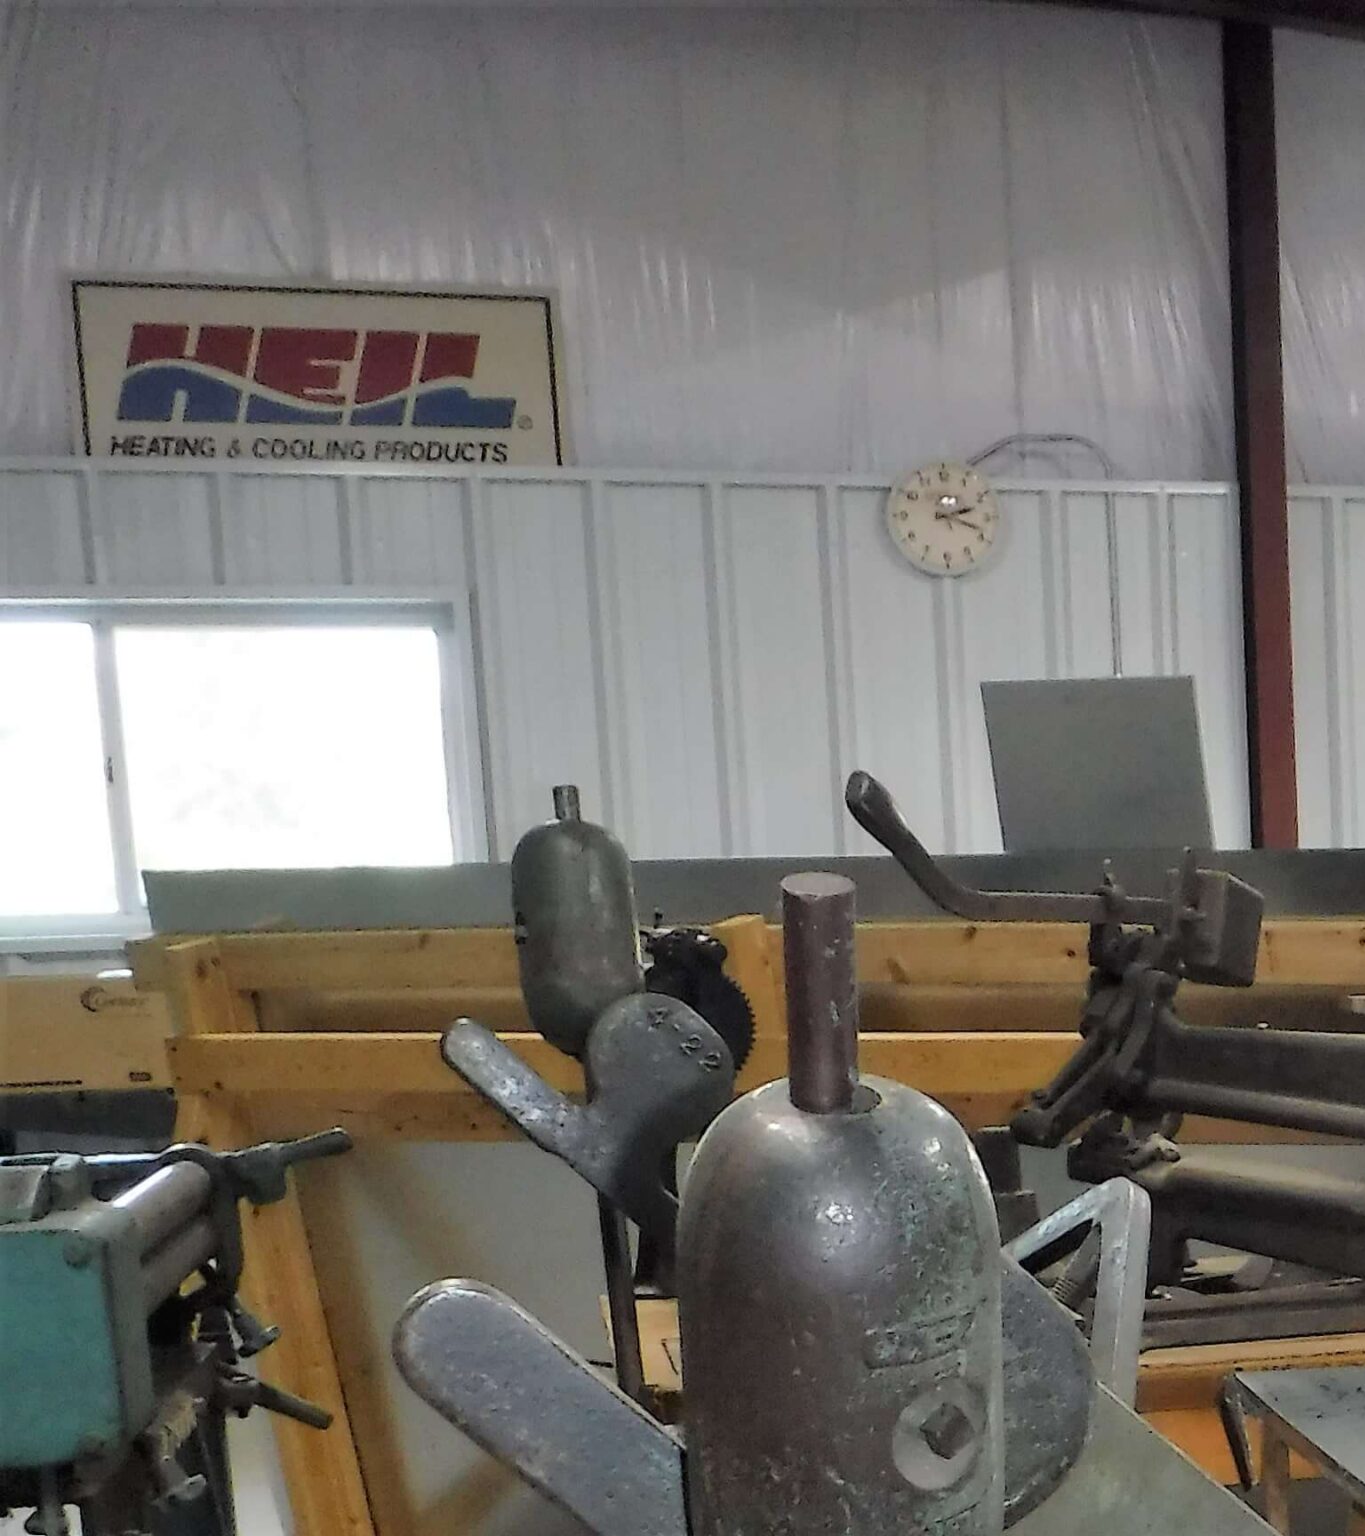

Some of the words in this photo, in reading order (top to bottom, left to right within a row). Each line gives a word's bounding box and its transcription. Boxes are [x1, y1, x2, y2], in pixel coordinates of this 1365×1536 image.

[117, 322, 516, 429] HEIL
[110, 435, 215, 457] HEATING
[226, 439, 241, 458] &
[252, 437, 366, 461] COOLING
[374, 440, 508, 463] PRODUCTS
